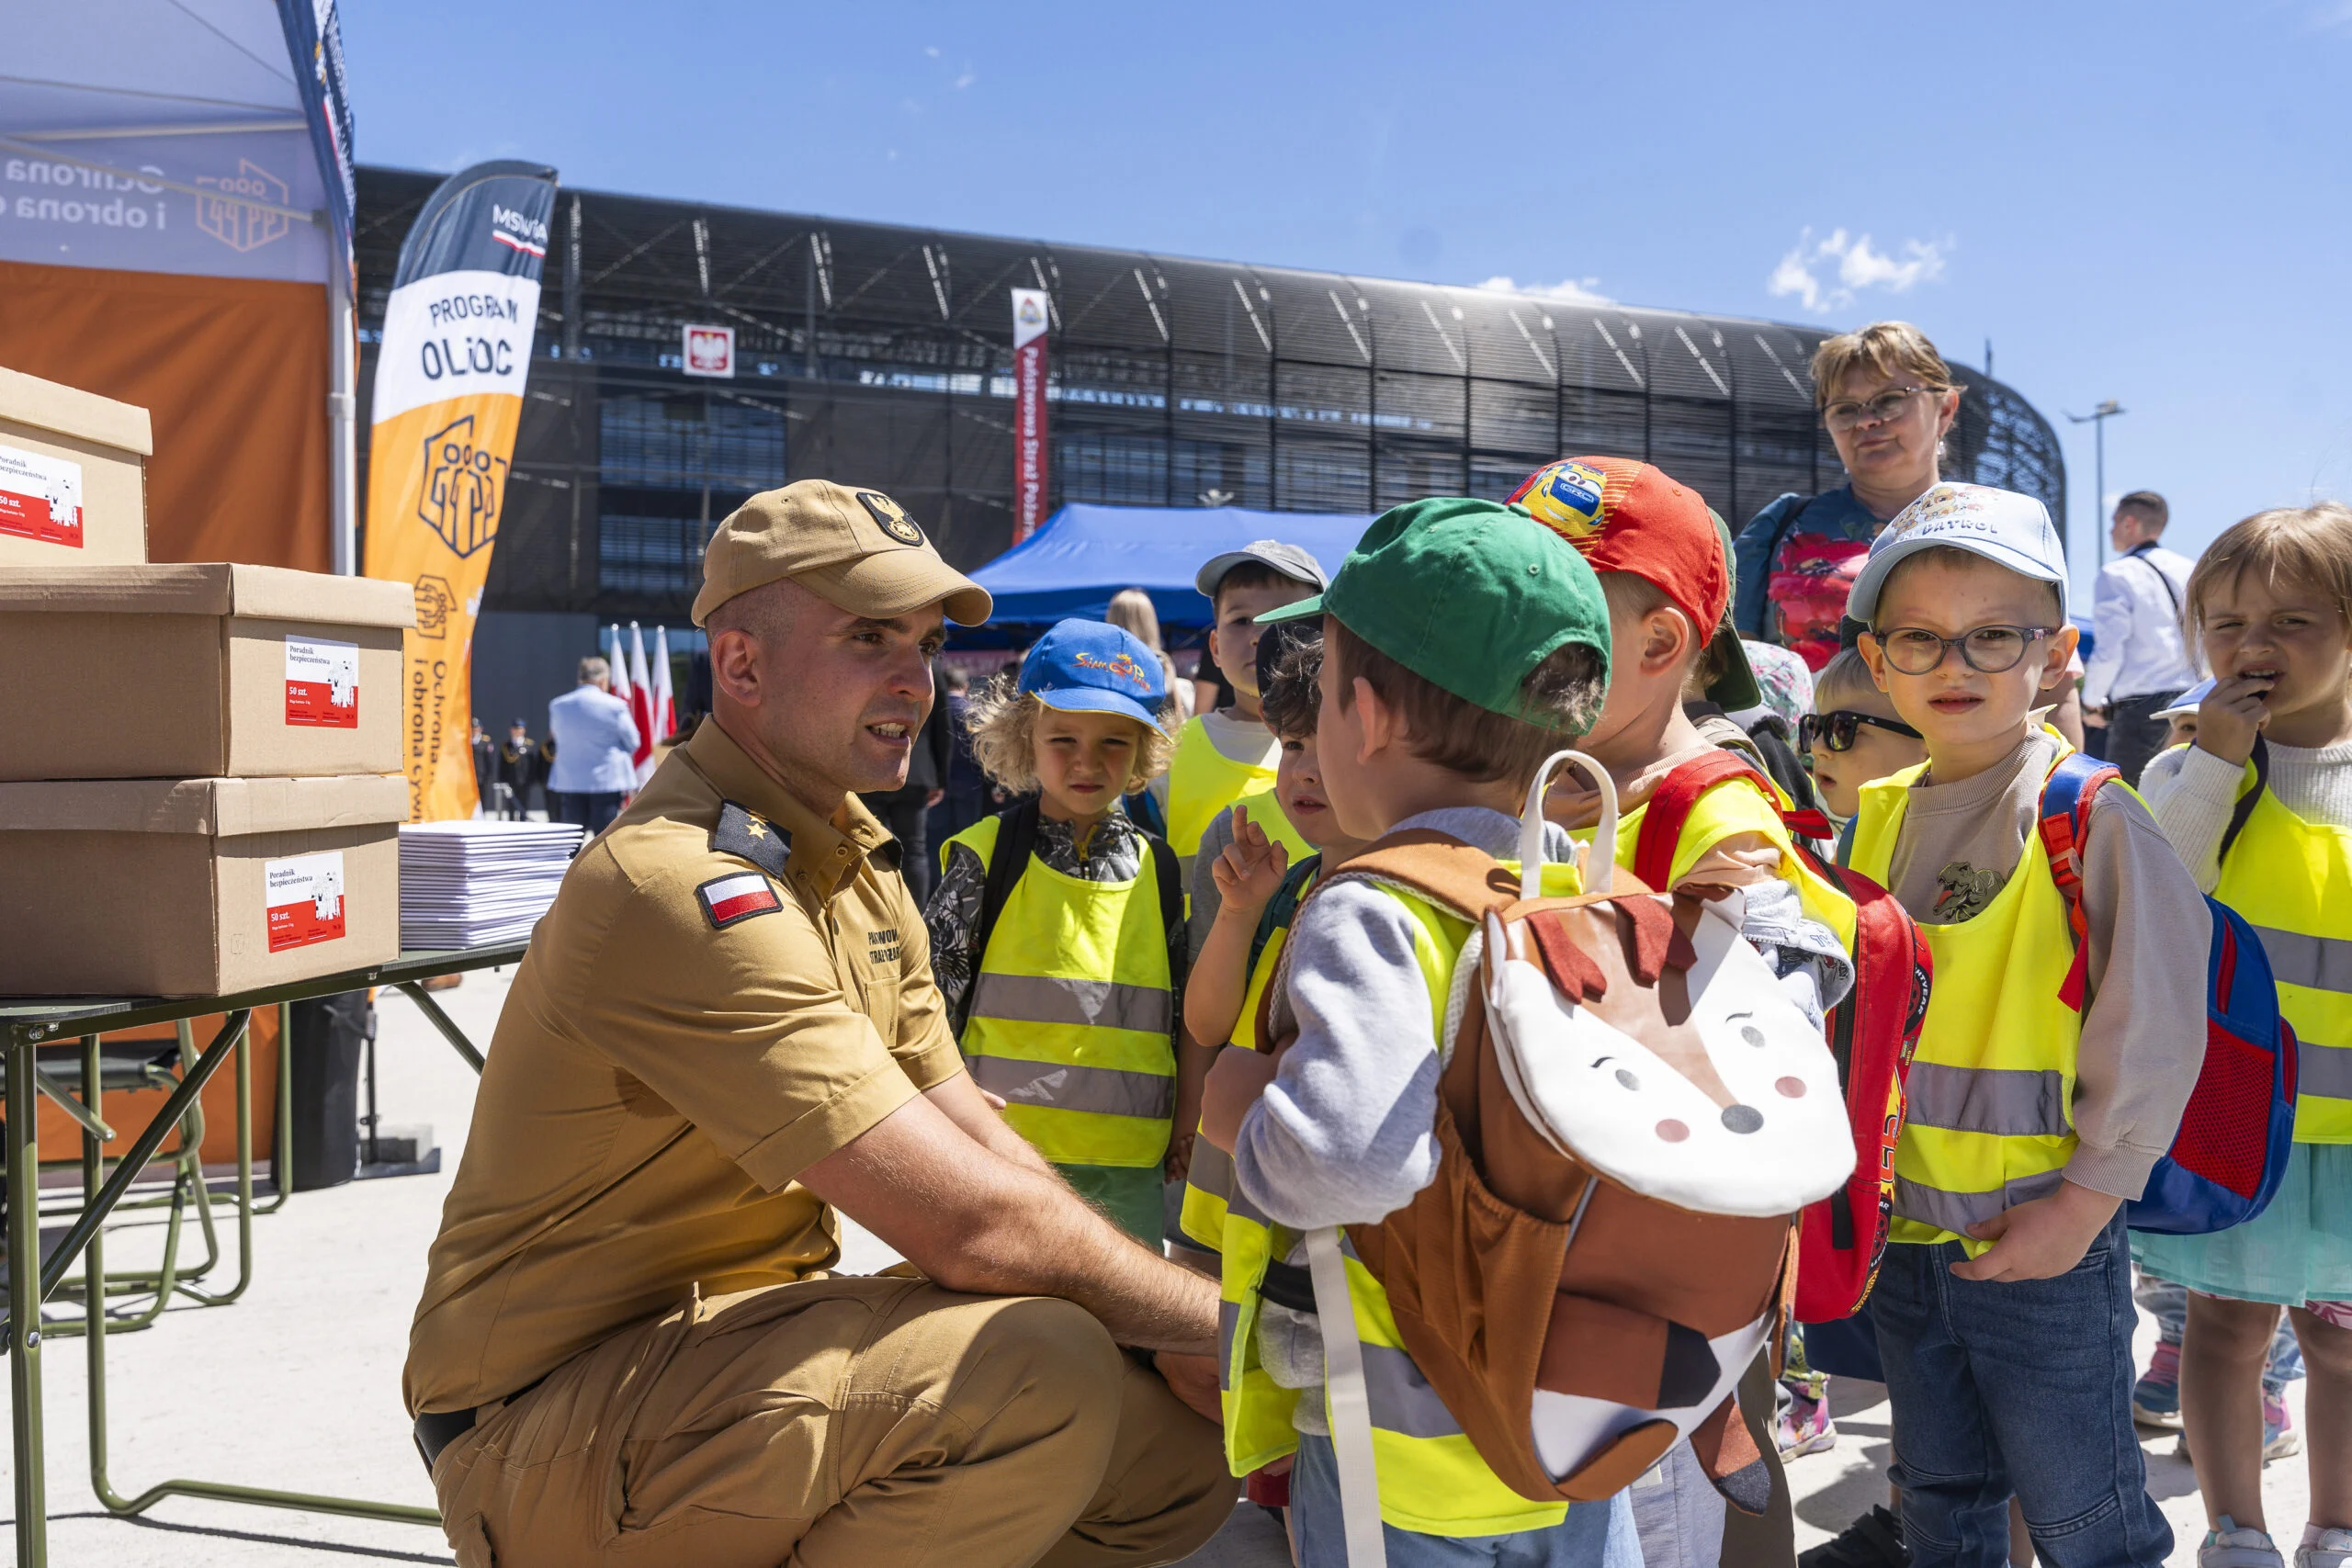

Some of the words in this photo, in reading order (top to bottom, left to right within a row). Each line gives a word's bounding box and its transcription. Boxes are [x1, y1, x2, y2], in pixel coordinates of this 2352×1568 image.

[289, 645, 313, 654] Poradnik
[289, 653, 330, 665] bezpieczeństwa
[288, 686, 297, 695] 50
[412, 672, 428, 758] obrona
[269, 868, 295, 879] Poradnik
[269, 875, 312, 888] bezpieczeństwa
[270, 912, 278, 922] 50
